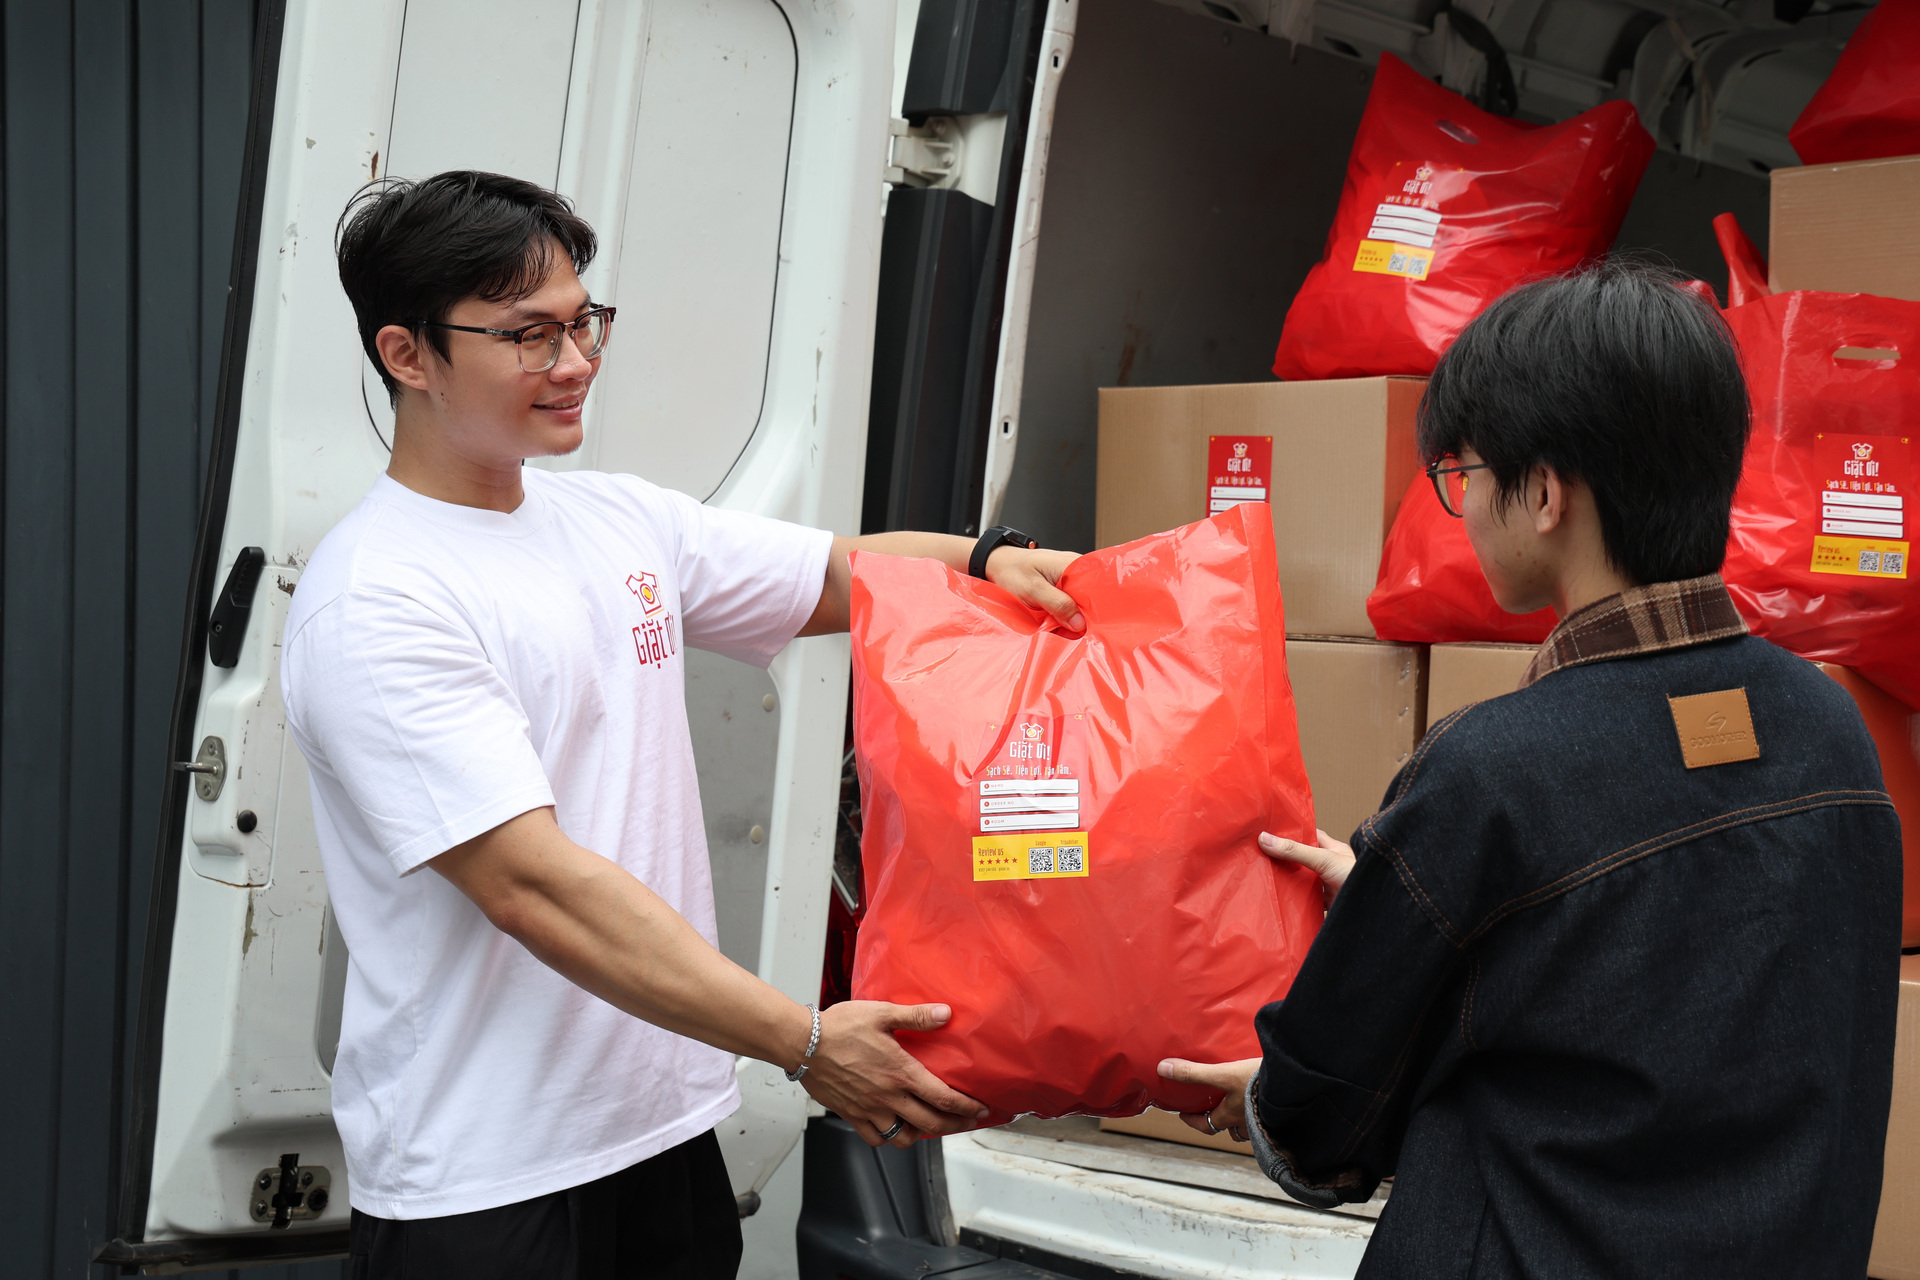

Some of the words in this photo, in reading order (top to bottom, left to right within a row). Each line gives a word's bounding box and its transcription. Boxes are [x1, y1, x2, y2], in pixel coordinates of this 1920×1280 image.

[1844, 460, 1864, 478] Giặt
[632, 619, 668, 669] Giặt
[1010, 741, 1033, 761] Giặt
